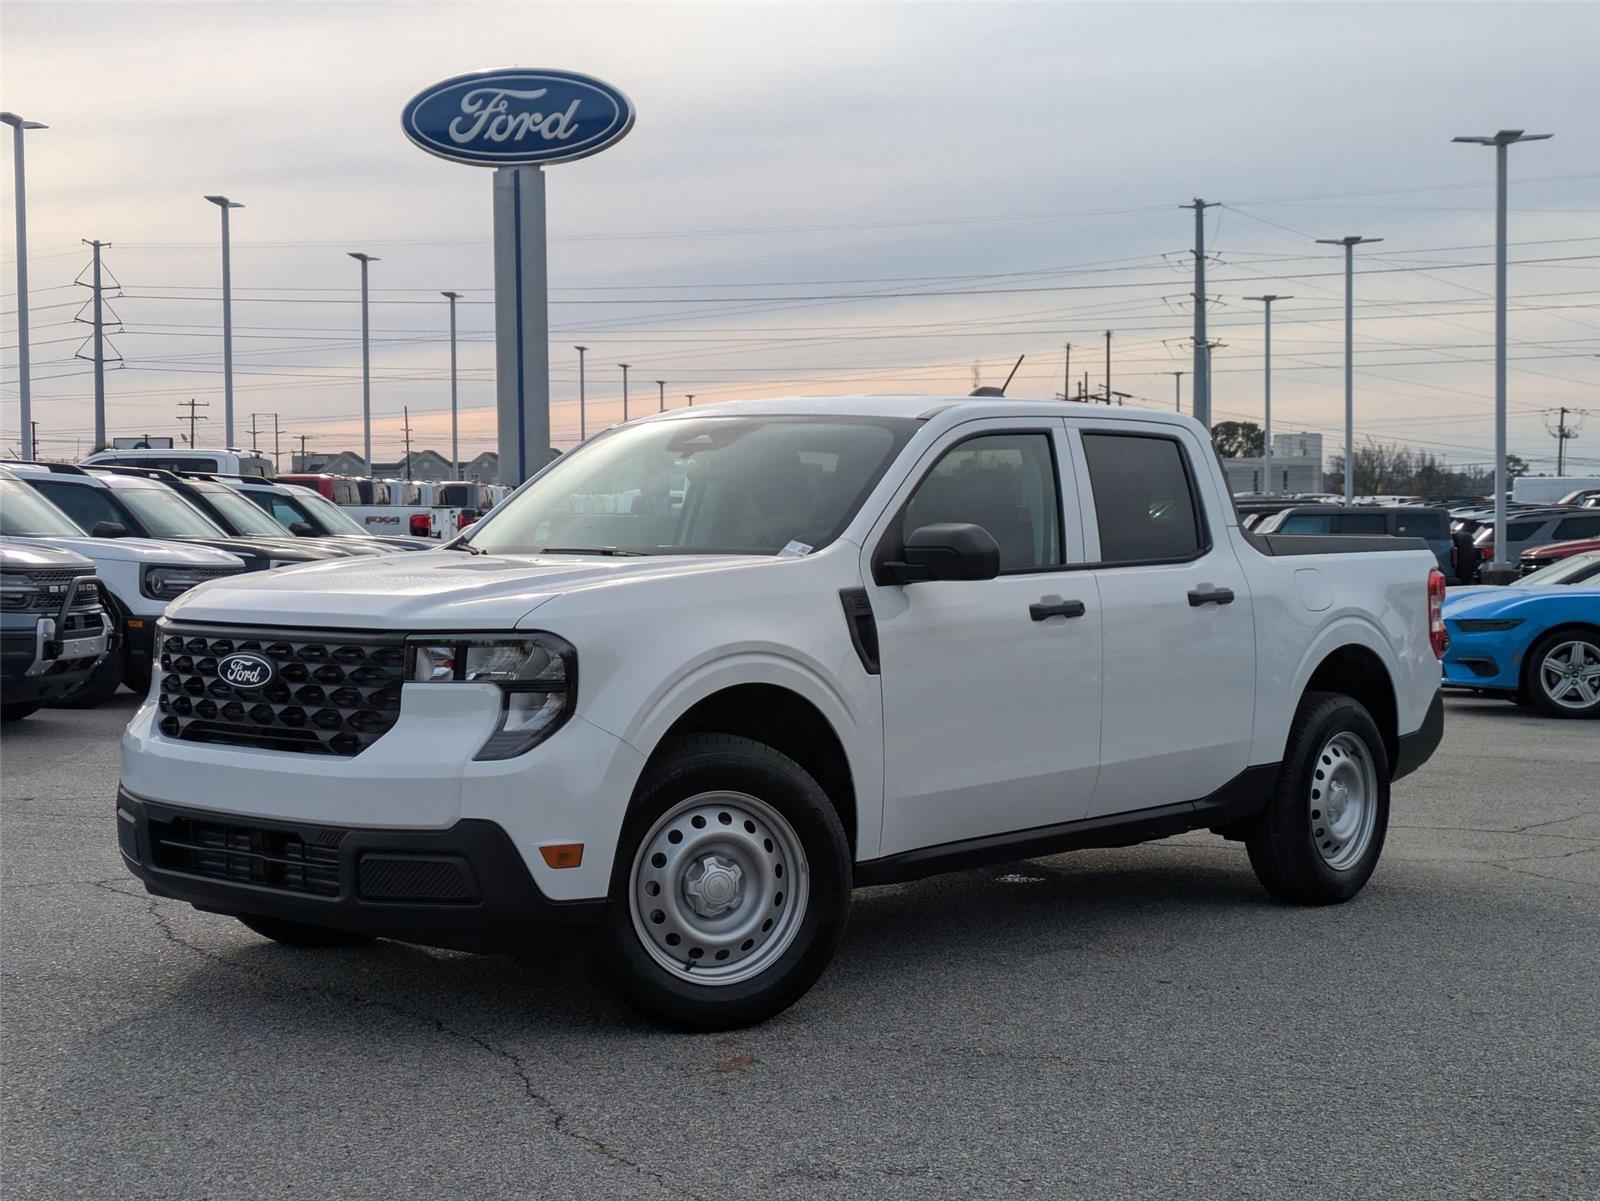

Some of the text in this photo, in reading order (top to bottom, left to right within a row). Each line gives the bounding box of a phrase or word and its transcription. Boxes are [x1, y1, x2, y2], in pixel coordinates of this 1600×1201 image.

[449, 88, 581, 143] Ford
[365, 516, 400, 525] FX4
[49, 583, 98, 593] BRNC
[227, 659, 261, 682] Ford
